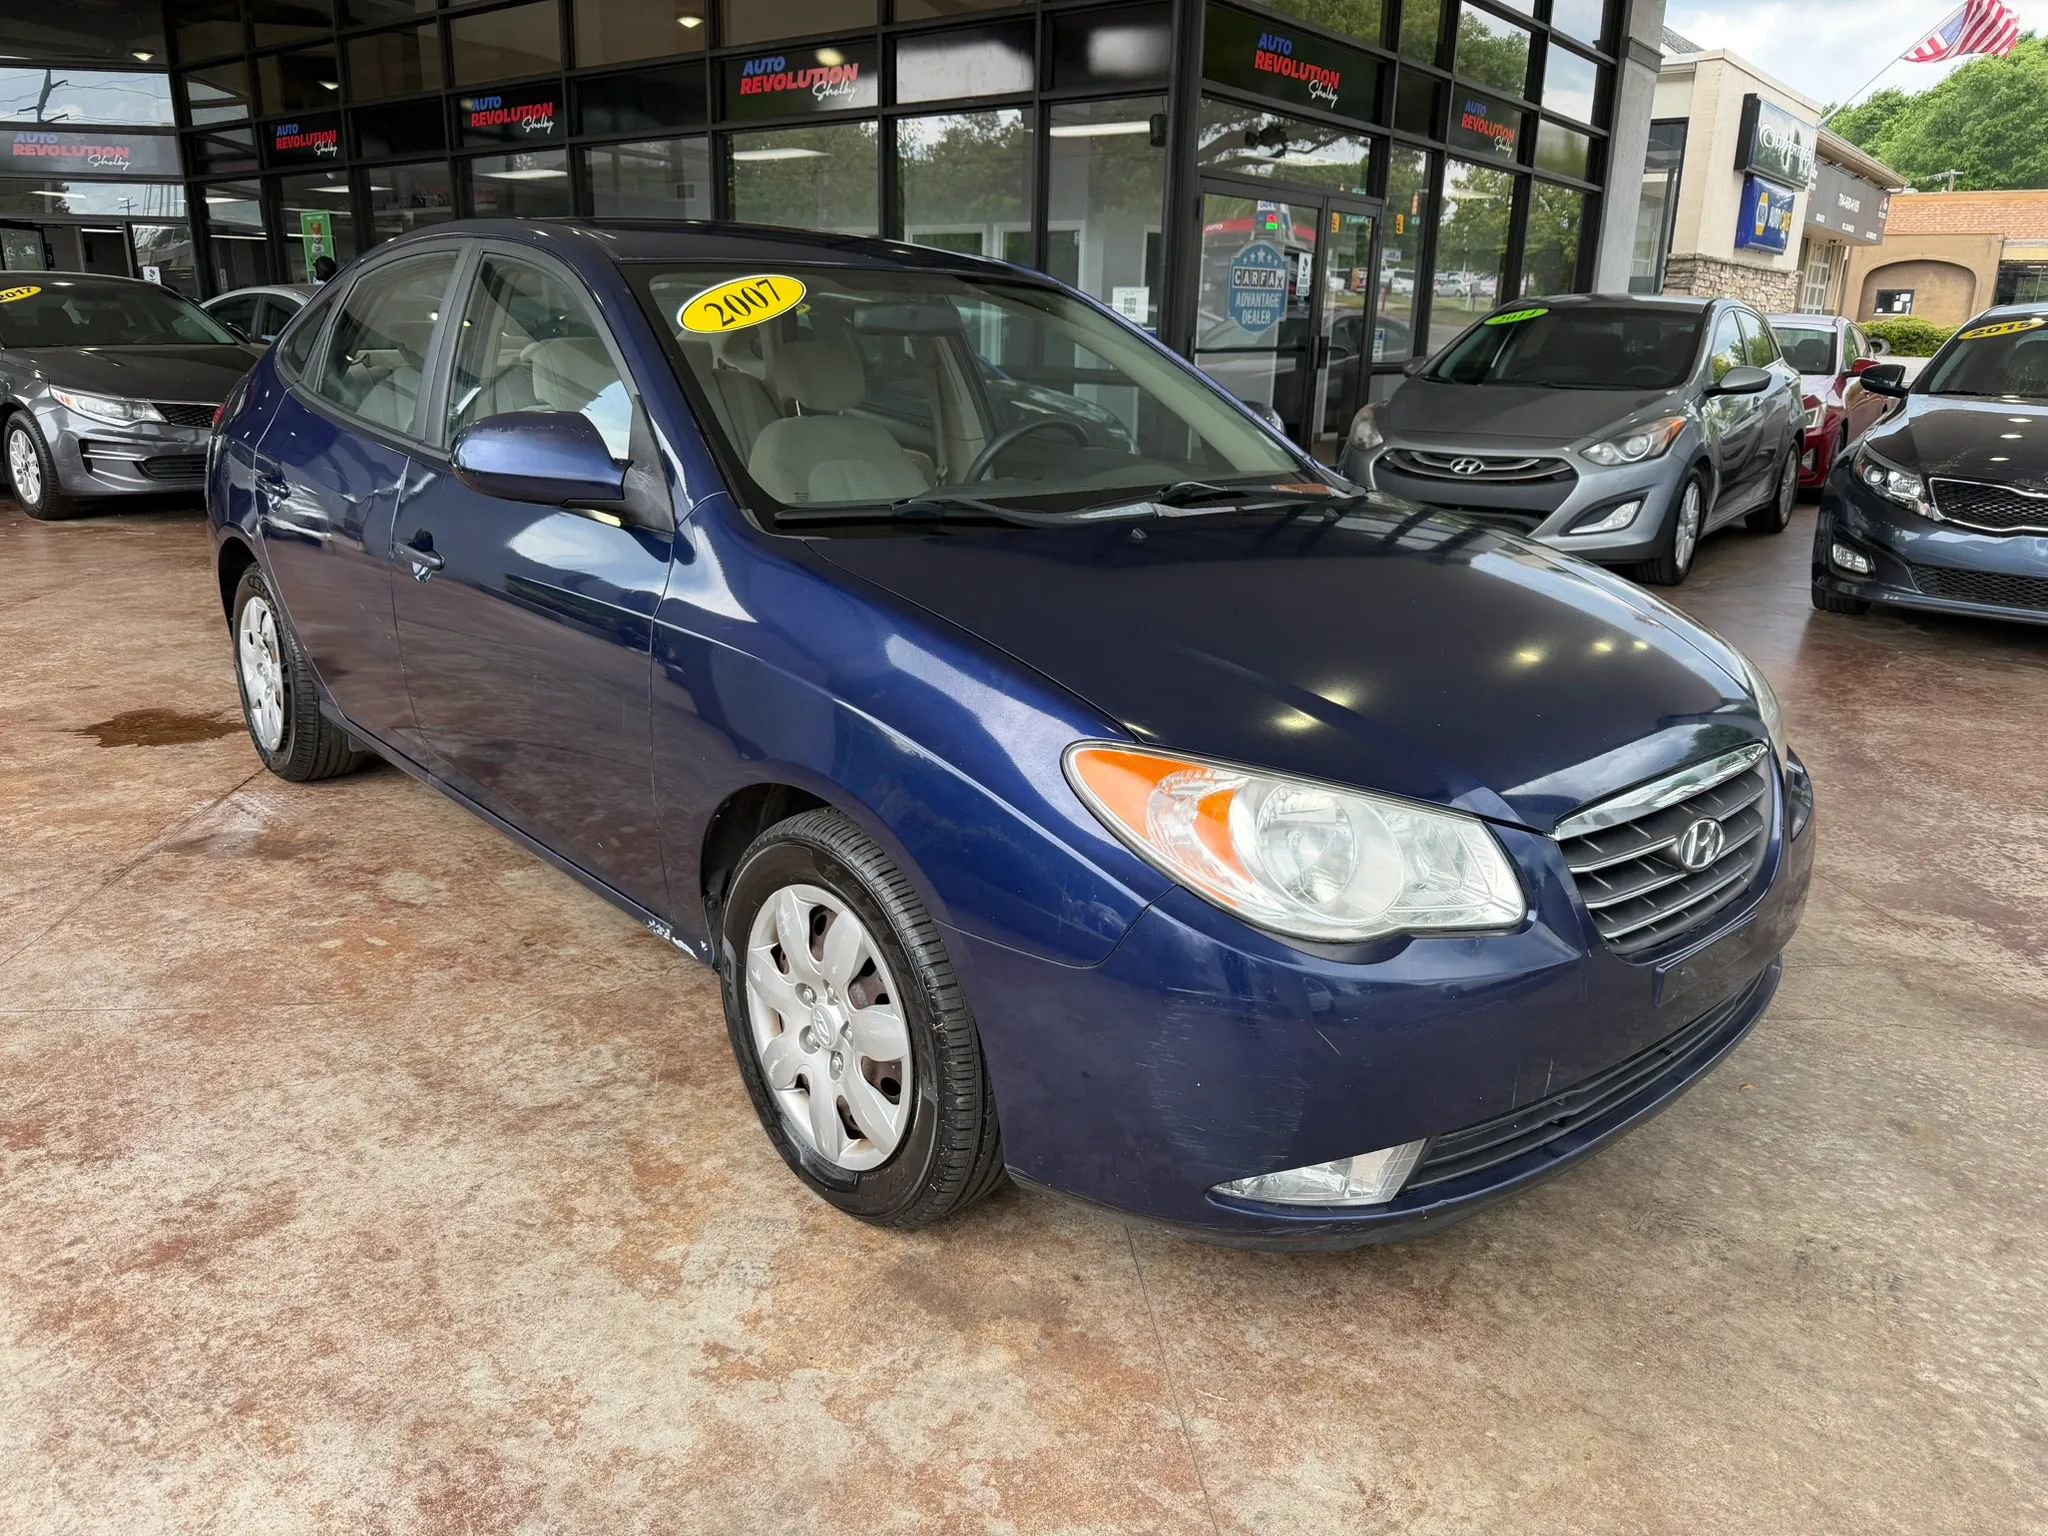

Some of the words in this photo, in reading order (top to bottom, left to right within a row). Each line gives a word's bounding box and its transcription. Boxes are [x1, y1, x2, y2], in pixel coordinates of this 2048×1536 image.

[1258, 33, 1292, 55] AUTO
[743, 56, 785, 76] AUTO
[1255, 50, 1340, 89] REVOLUTION
[740, 63, 859, 95] REVOLUTION
[812, 78, 857, 102] Shelby
[1308, 79, 1338, 109] Shelby
[472, 96, 501, 111] AUTO
[1465, 100, 1487, 116] AUTO
[471, 102, 553, 128] REVOLUTION
[522, 113, 554, 134] Shelby
[15, 133, 59, 143] AUTO
[277, 124, 299, 136] AUTO
[1462, 113, 1515, 143] REVOLUTION
[13, 144, 130, 158] REVOLUTION
[276, 130, 336, 151] REVOLUTION
[88, 154, 131, 171] Shelby
[1234, 267, 1285, 289] CARFAX
[0, 287, 32, 300] 2017
[704, 279, 780, 327] 2007
[1235, 291, 1280, 308] ADVANTAGE
[1241, 309, 1272, 325] DEALER
